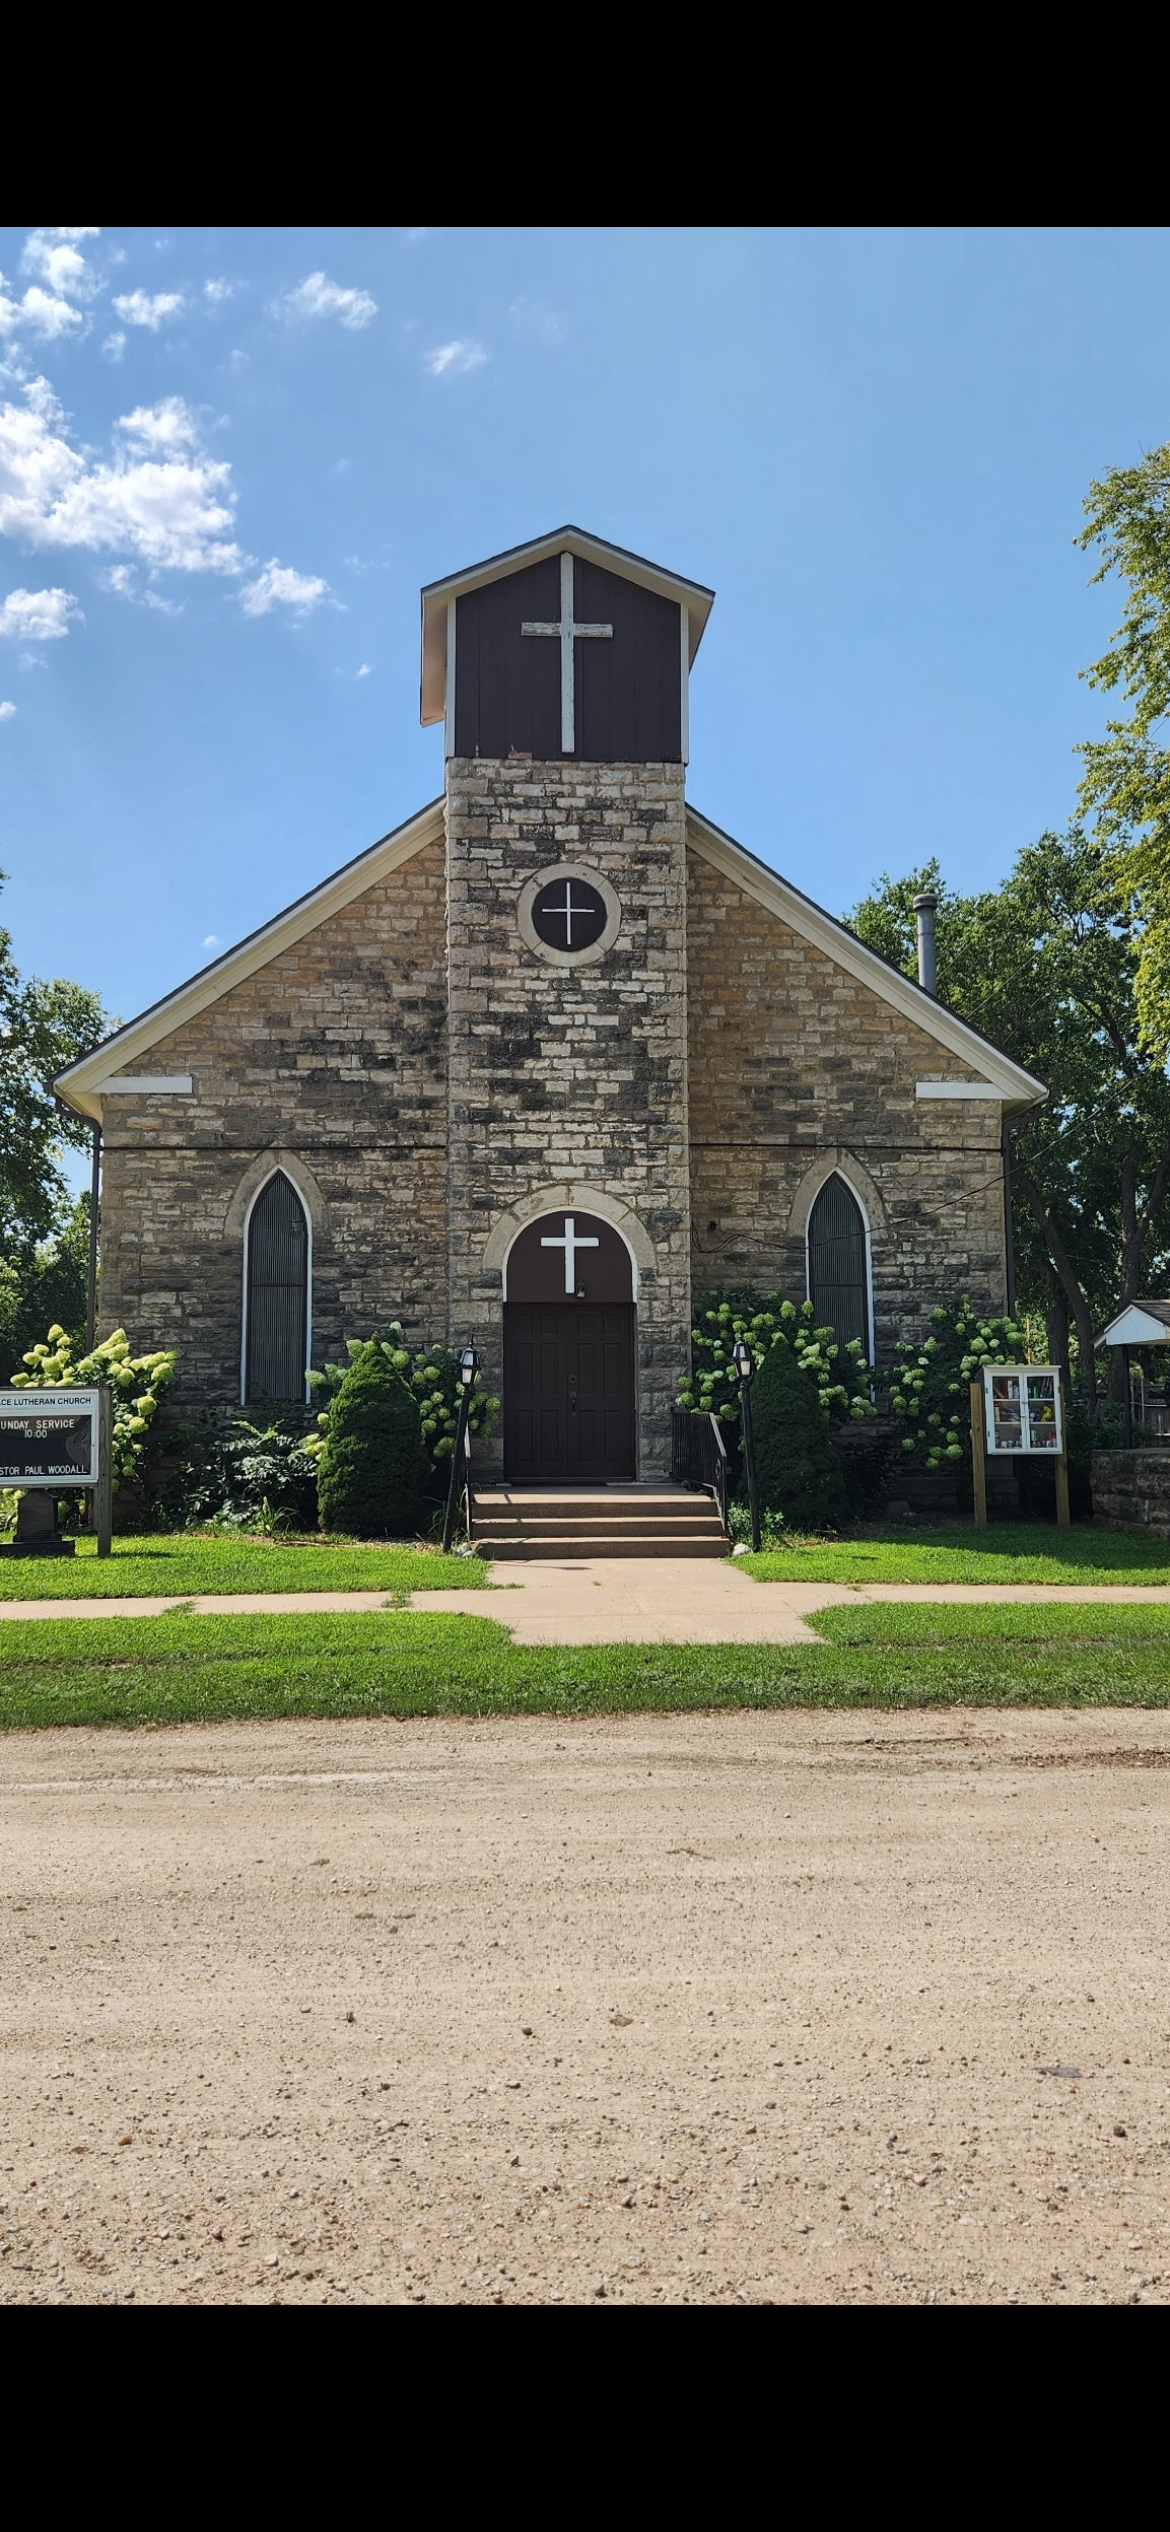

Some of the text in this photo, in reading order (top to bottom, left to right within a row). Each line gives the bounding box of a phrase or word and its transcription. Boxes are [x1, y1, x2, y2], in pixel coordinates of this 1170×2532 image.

[13, 1398, 56, 1406] LUTHERAN
[57, 1397, 91, 1405] CHURCH
[36, 1419, 75, 1429] SERVICE
[24, 1429, 48, 1438] 10:00
[25, 1465, 45, 1475] PAUL
[48, 1465, 87, 1474] WOODALL
